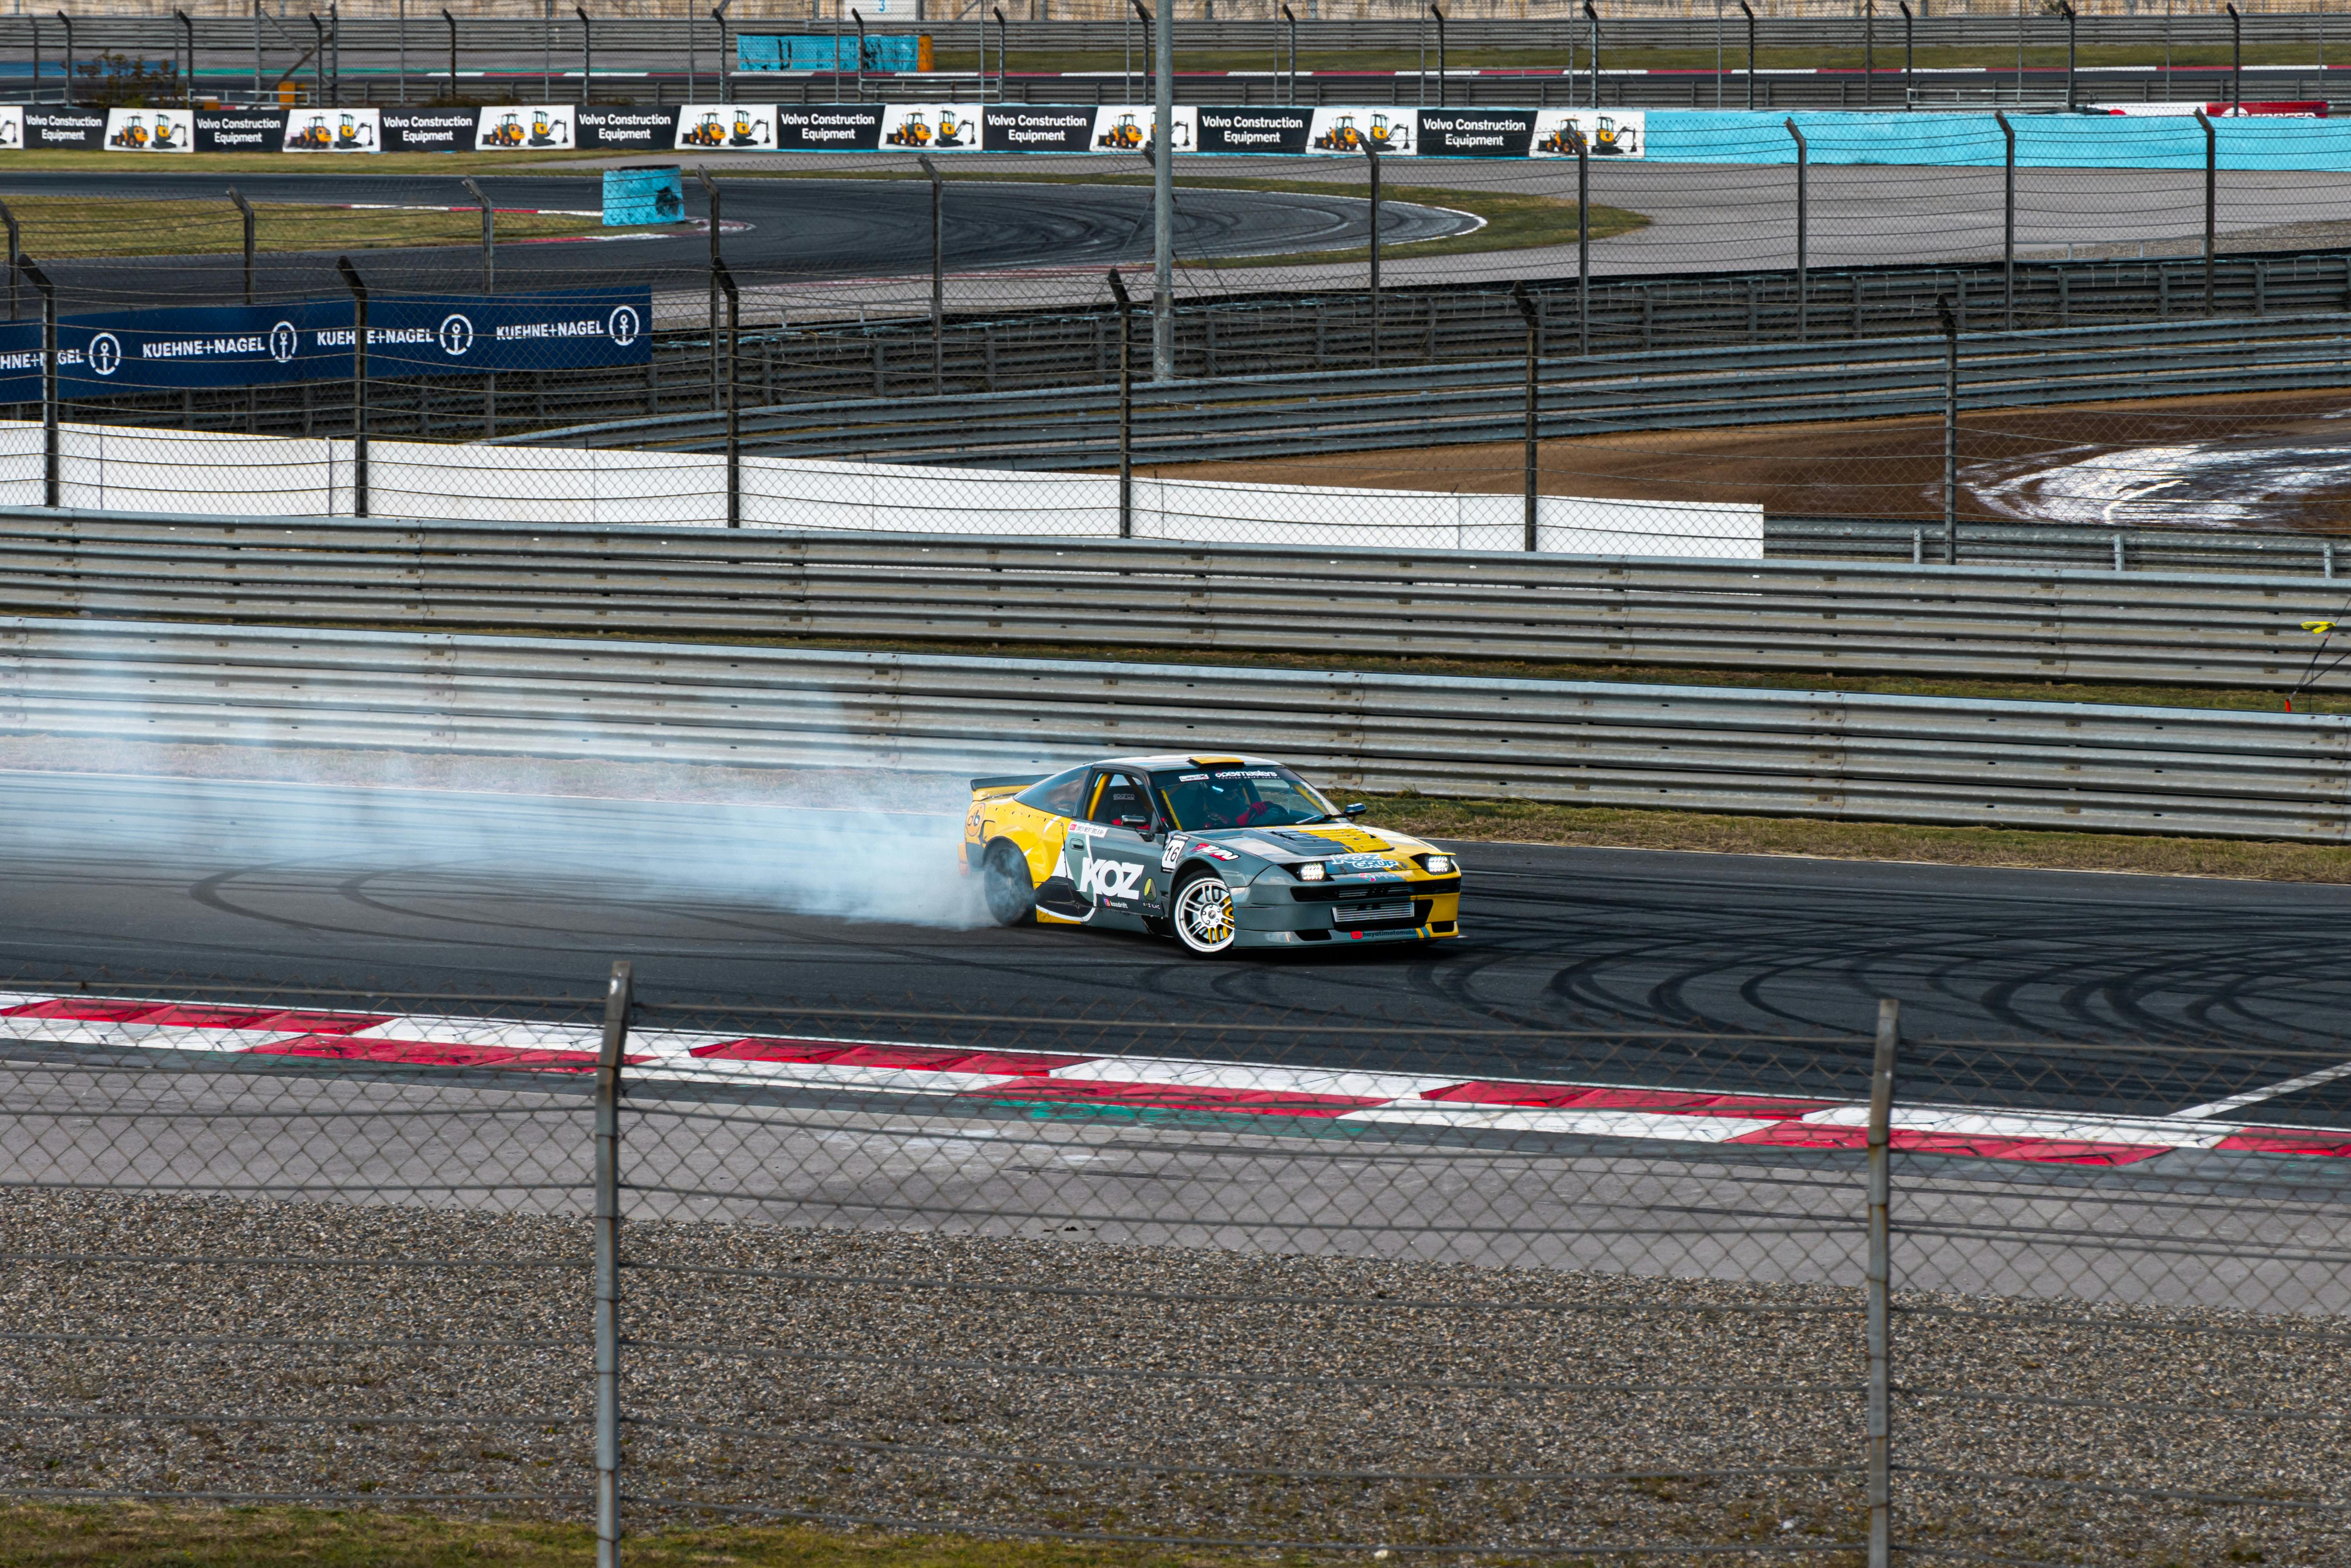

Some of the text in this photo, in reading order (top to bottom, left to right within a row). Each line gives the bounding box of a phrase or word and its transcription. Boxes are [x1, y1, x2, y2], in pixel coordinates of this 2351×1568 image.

[26, 115, 102, 126] Volvo Construction
[197, 118, 280, 129] Volvo Construction
[383, 116, 472, 127] Volvo Construction
[579, 114, 671, 125] Volvo Construction
[781, 114, 875, 125] Volvo Construction
[987, 115, 1086, 126] Volvo Construction
[1202, 116, 1302, 128] Volvo Construction
[1423, 119, 1525, 130] Volvo Construction
[42, 129, 85, 141] Equipment
[215, 132, 262, 144] Equipment
[403, 130, 453, 143] Equipment
[599, 128, 651, 141] Equipment
[802, 128, 855, 141] Equipment
[1009, 130, 1065, 143] Equipment
[1225, 131, 1280, 144] Equipment
[1446, 134, 1503, 147] Equipment
[496, 320, 604, 340] KUEHNE+NAGEL
[317, 328, 434, 345] KUEHE+NAGEL
[143, 337, 266, 358] KUEHNE+NAGEL
[0, 349, 84, 369] HNE+GEL
[1166, 846, 1180, 862] 16
[1330, 853, 1383, 865] KOZ
[1352, 860, 1399, 869] GRUP
[1079, 857, 1145, 900] KOZ
[1110, 900, 1128, 909] kozdrift
